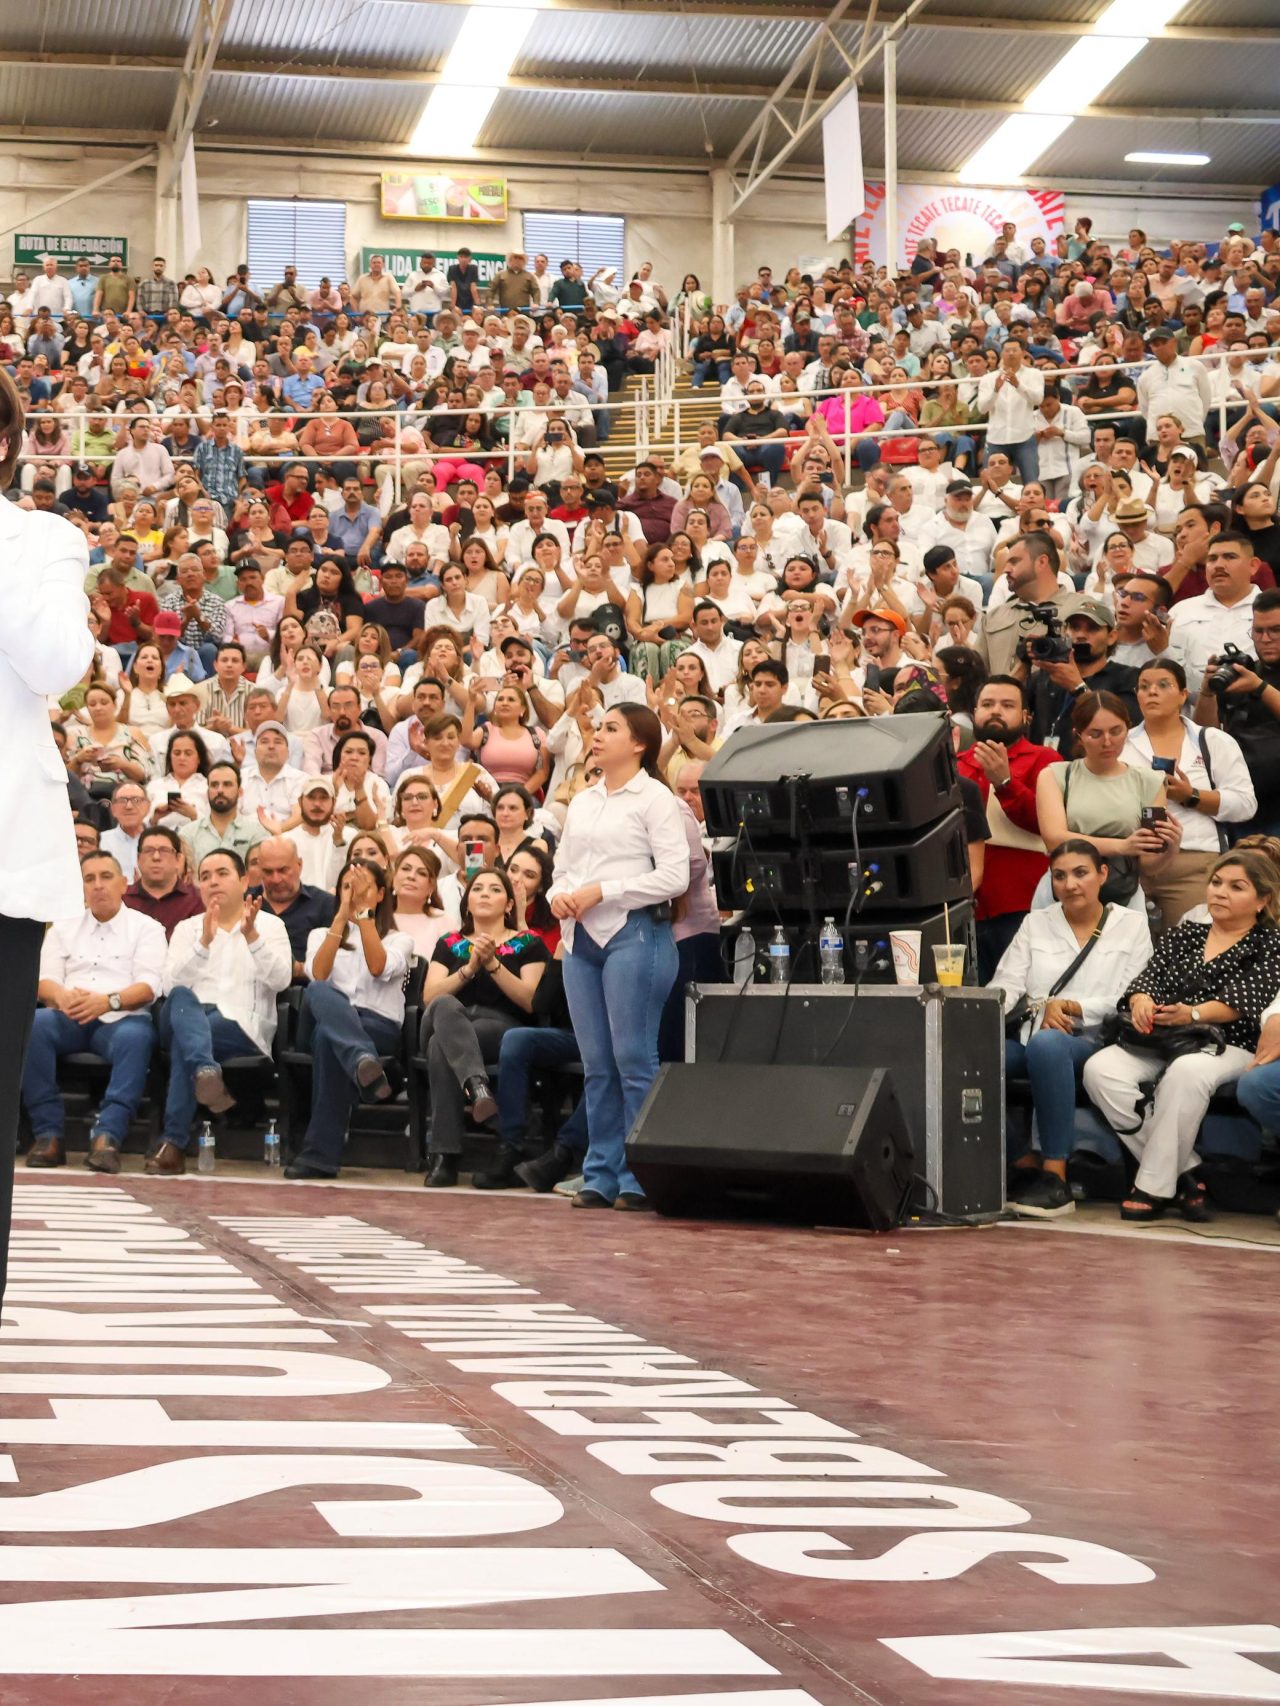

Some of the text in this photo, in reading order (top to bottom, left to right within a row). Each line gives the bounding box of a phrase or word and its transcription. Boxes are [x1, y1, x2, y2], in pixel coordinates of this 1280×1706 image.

[907, 202, 942, 236] TECATE
[940, 196, 982, 215] TECATE
[19, 236, 45, 251] RUTA
[46, 237, 60, 251] DE
[207, 1215, 542, 1295] NACIONAL
